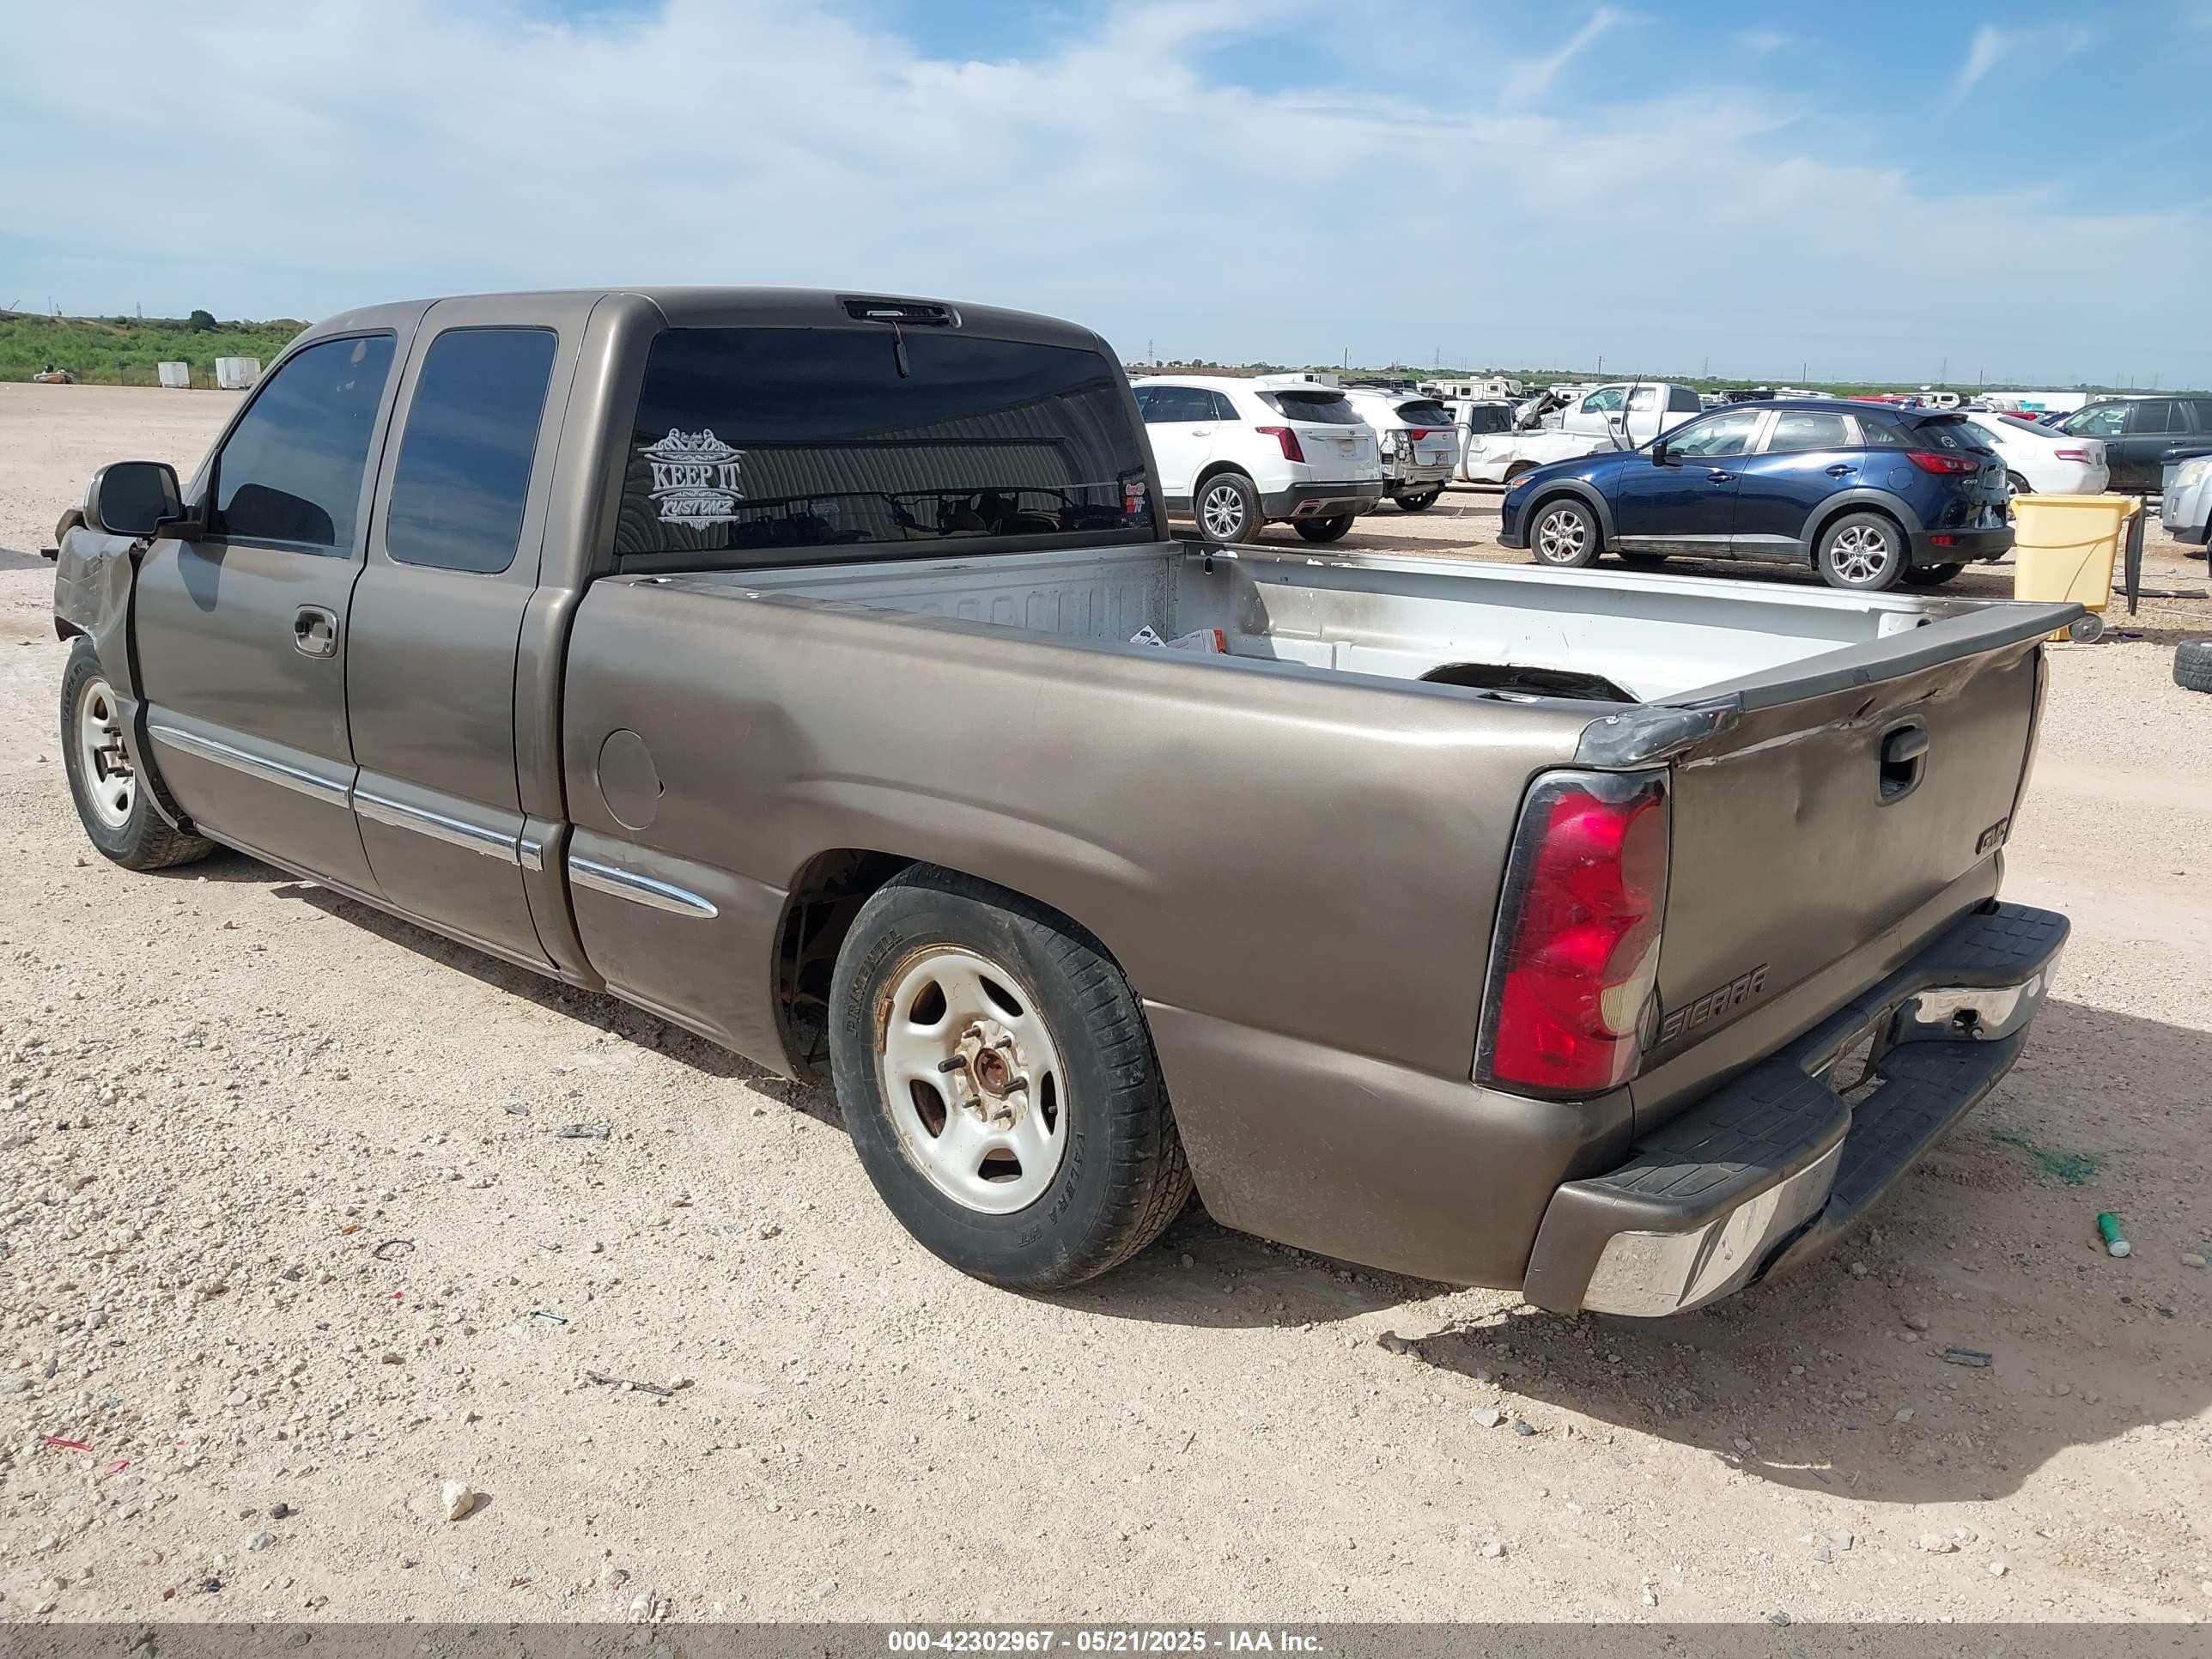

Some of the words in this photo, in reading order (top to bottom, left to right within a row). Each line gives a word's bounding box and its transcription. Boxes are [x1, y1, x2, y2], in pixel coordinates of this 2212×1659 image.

[650, 463, 713, 491] KEEP
[718, 463, 741, 491] IT
[661, 500, 735, 516] KUSTOMZ
[1661, 963, 1771, 1042] SIERRA
